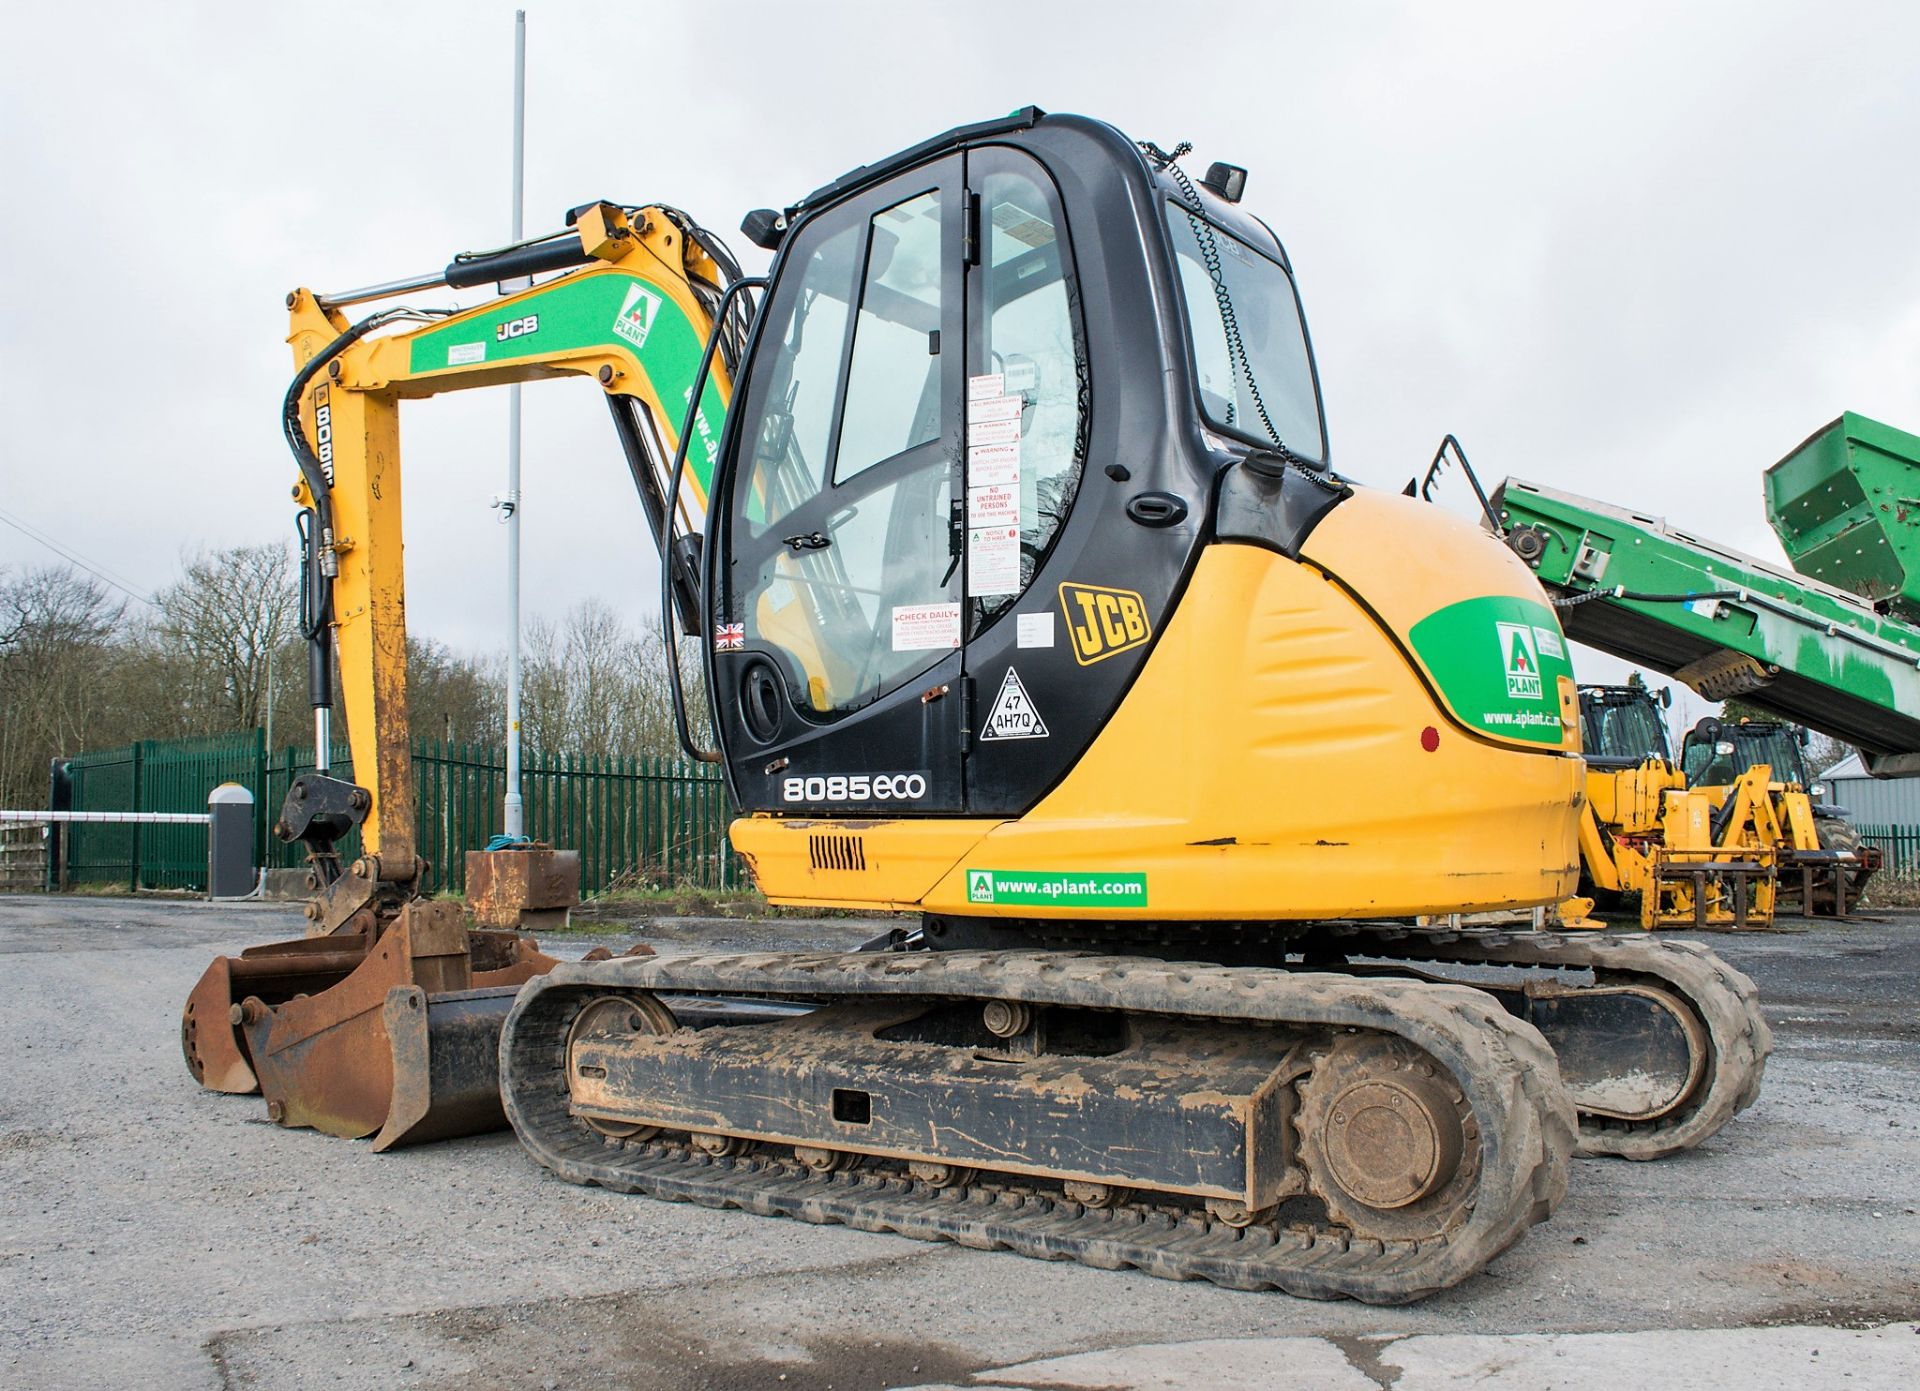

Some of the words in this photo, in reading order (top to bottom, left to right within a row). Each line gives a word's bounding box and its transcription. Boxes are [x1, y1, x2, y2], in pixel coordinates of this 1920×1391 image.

[497, 314, 538, 341] JCB
[615, 319, 646, 344] PLANT
[980, 446, 1009, 454] WARNING
[990, 486, 999, 494] NO
[977, 493, 1012, 503] UNTRAINED
[980, 501, 1008, 510] PERSONS
[899, 612, 927, 621] CHECK
[929, 610, 954, 619] DAILY
[1075, 590, 1145, 656] JCB
[1508, 678, 1541, 694] PLANT
[1005, 695, 1021, 710] 47
[997, 712, 1031, 729] AH7Q
[995, 879, 1142, 898] www.aplant.com
[971, 892, 993, 901] PLANT
